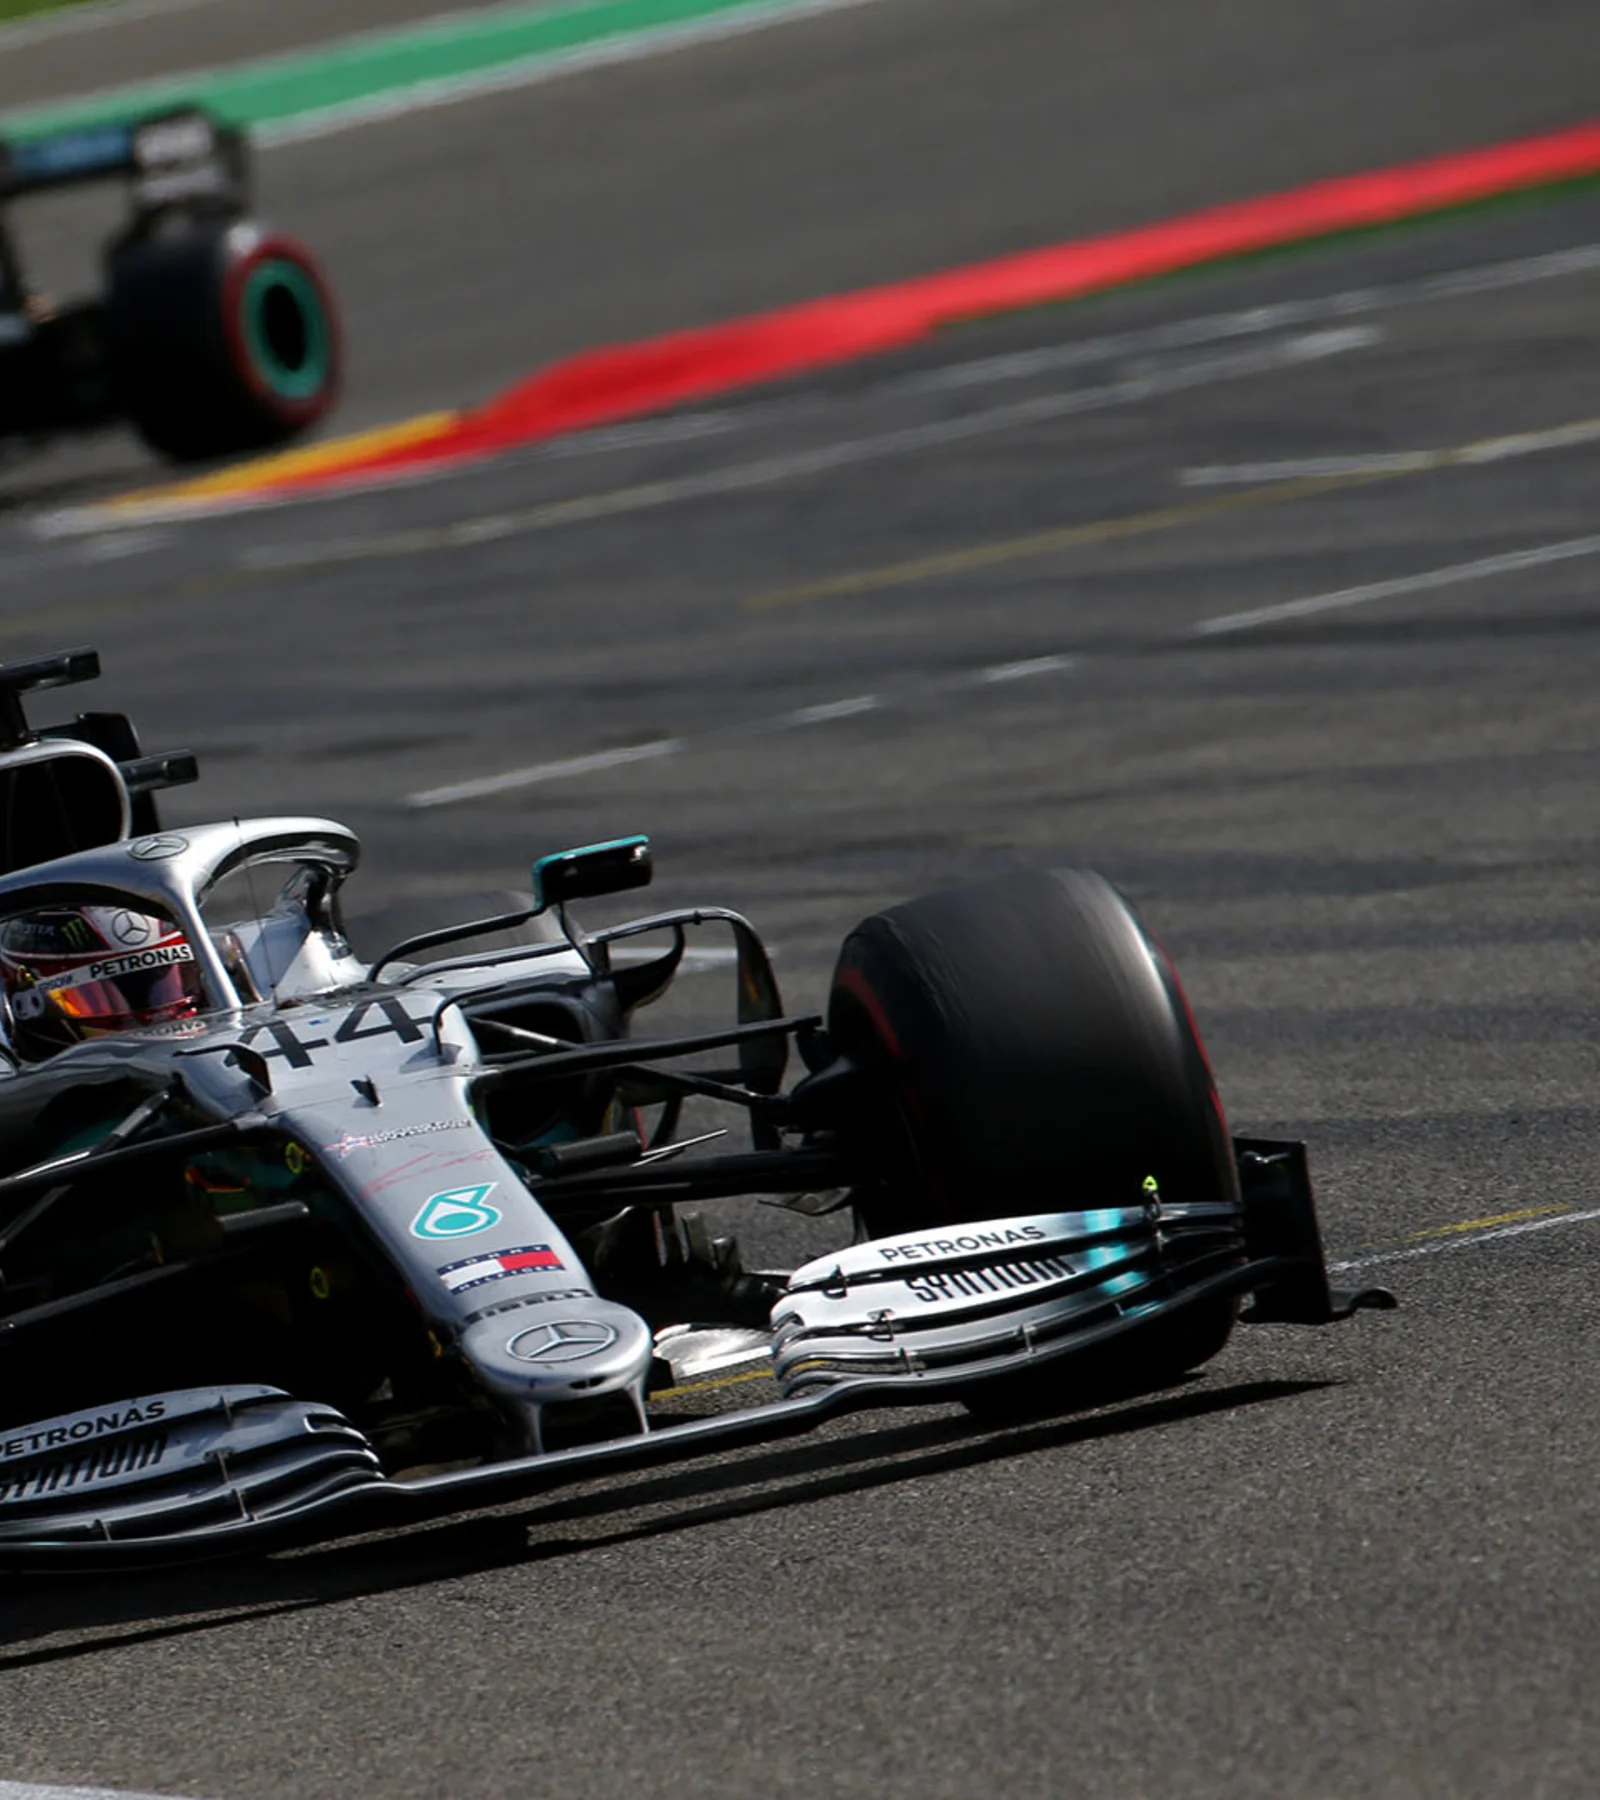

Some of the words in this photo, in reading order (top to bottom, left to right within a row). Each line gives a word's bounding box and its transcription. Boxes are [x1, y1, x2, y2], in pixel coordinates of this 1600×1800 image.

[90, 946, 190, 978] PETRONAS
[224, 995, 434, 1069] 44
[878, 1226, 1046, 1262] PETRONAS
